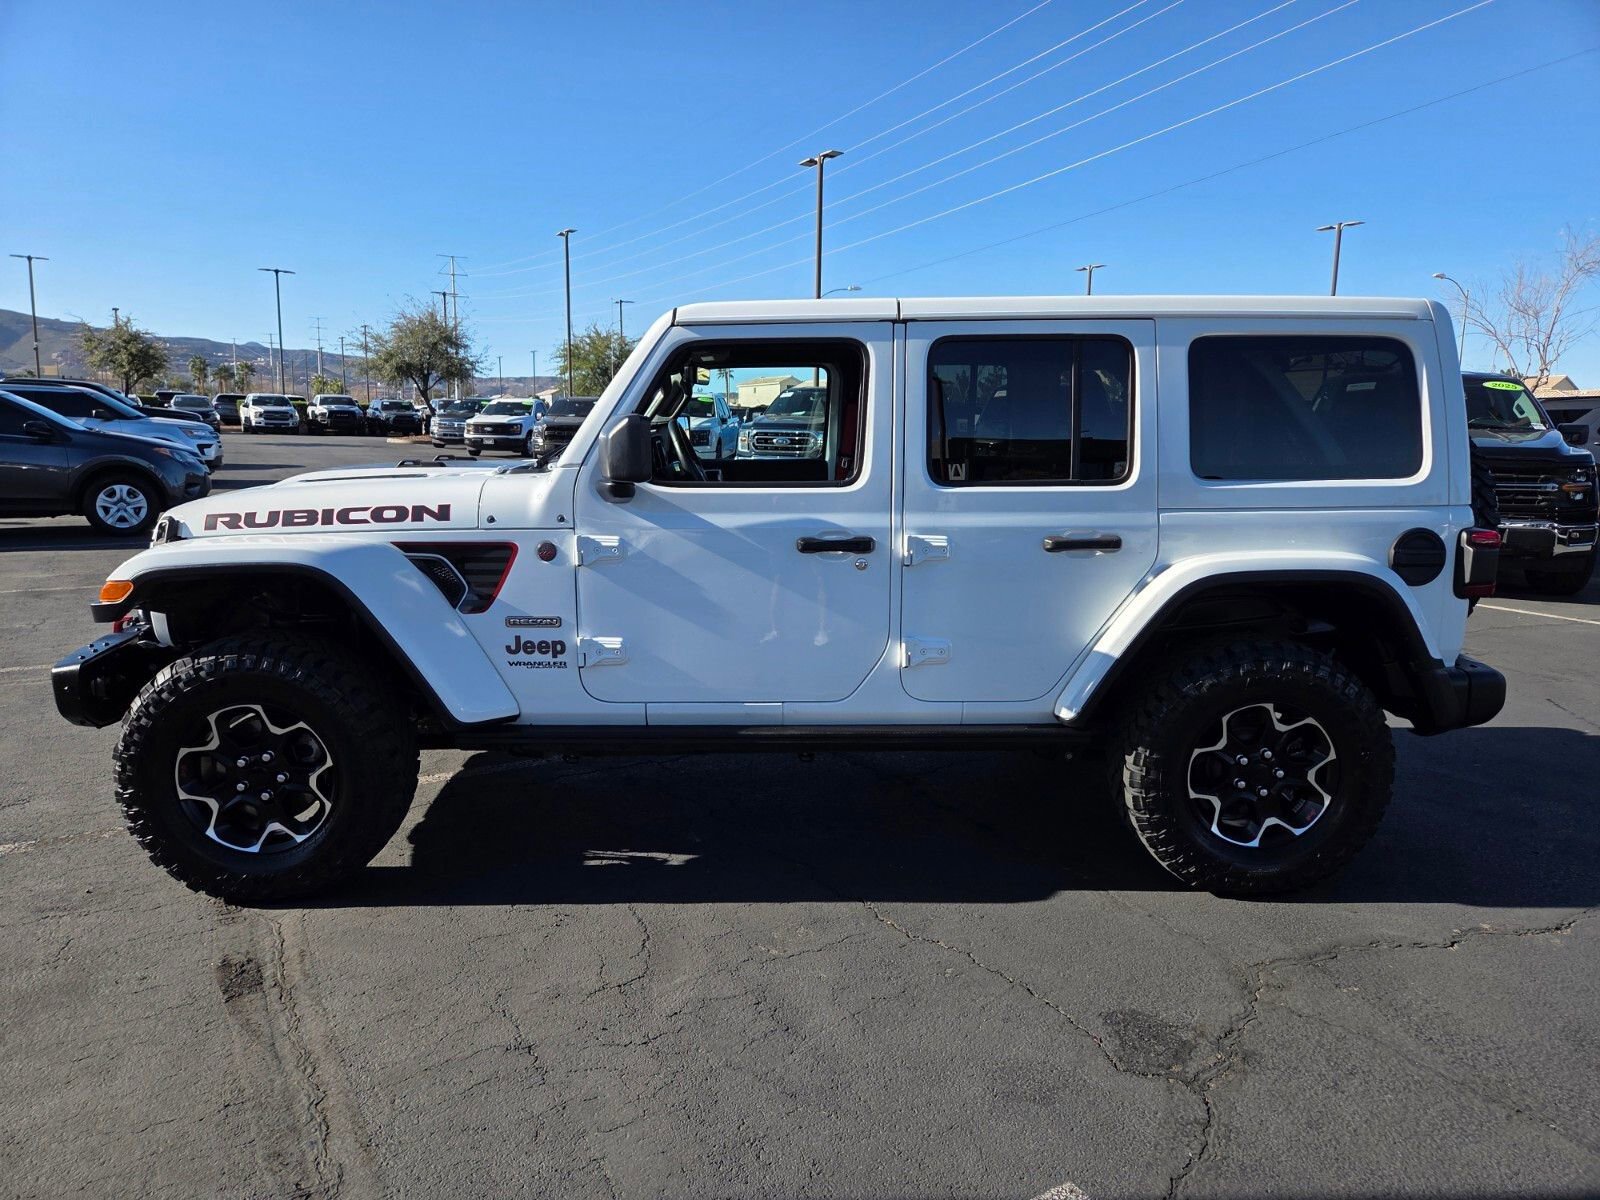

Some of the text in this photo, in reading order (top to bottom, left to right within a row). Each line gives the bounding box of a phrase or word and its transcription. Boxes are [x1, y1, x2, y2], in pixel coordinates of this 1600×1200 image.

[204, 503, 451, 531] RUBICON
[509, 618, 558, 626] RECON
[505, 635, 566, 659] Jeep
